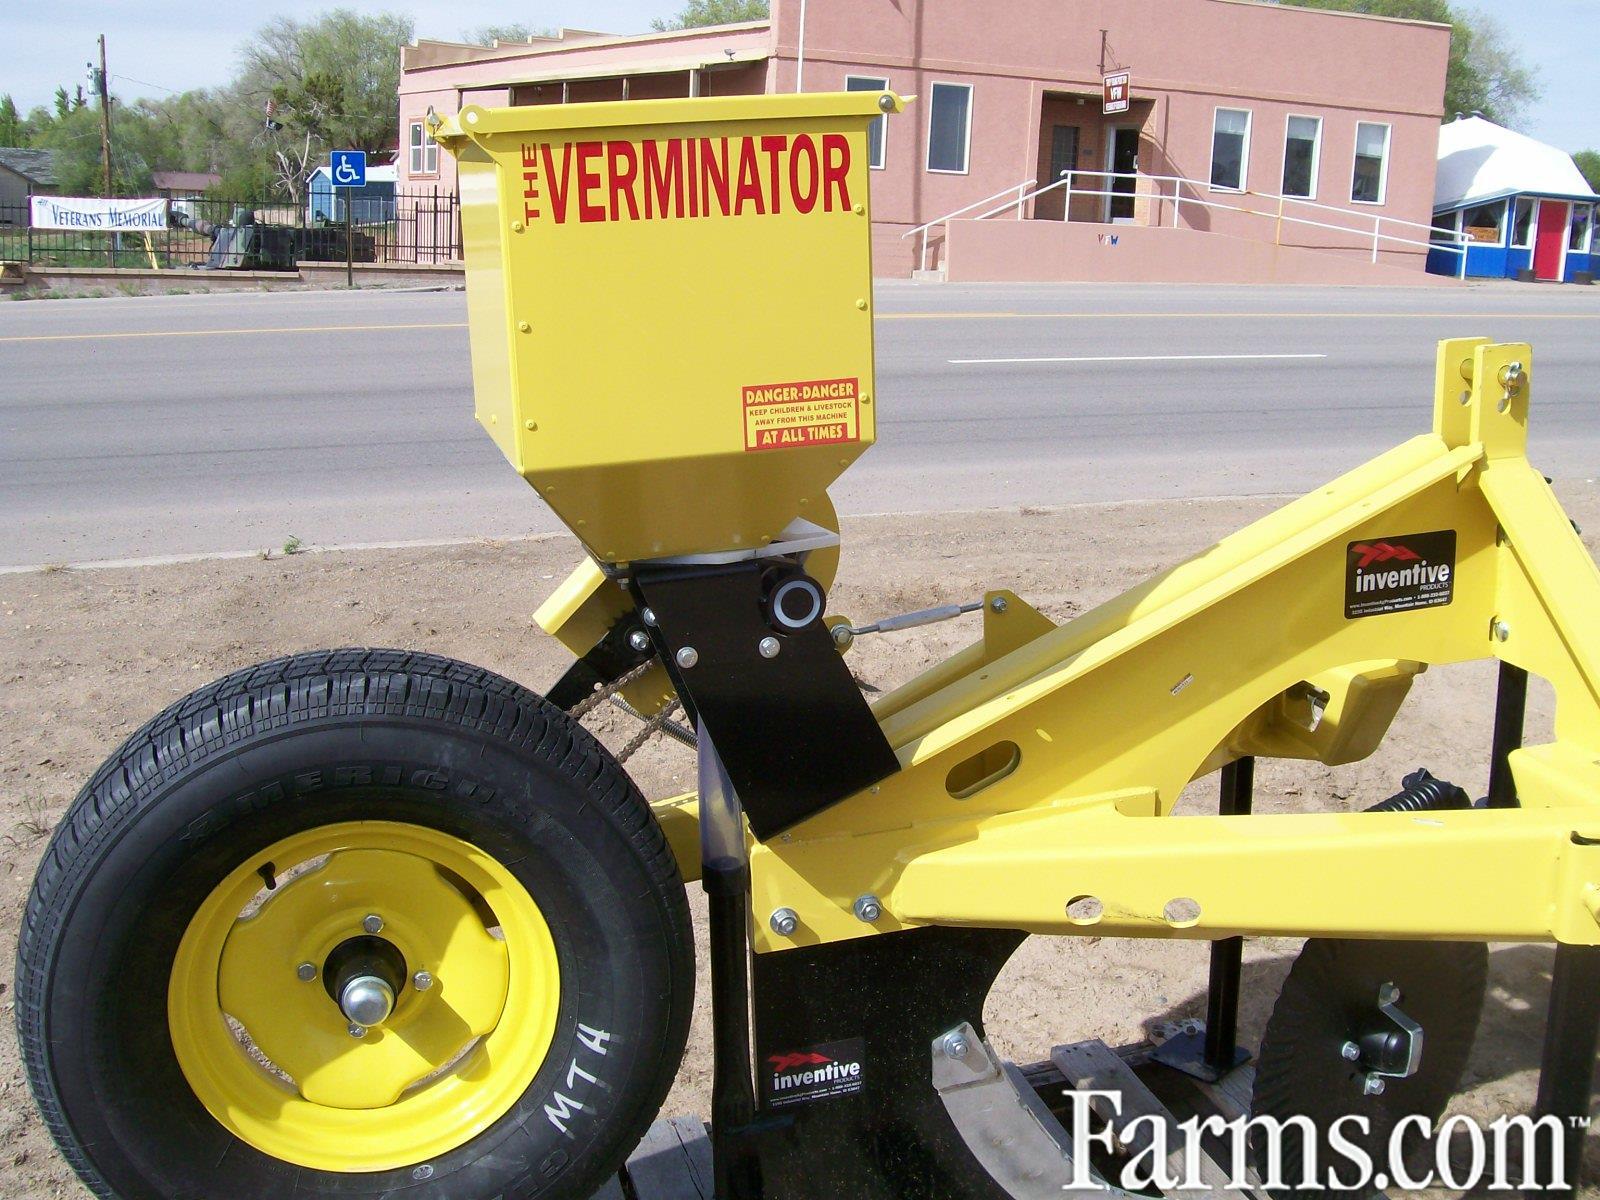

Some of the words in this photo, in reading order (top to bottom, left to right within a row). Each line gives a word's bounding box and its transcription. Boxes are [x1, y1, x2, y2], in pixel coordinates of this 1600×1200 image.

[521, 142, 541, 226] THE
[540, 133, 852, 225] VERMINATOR
[51, 204, 102, 227] VETERANS
[109, 206, 164, 227] MEMORIAL
[749, 408, 768, 417] KEEP
[769, 406, 806, 415] CHILDREN
[813, 401, 853, 411] LIVESTOCK
[754, 418, 775, 426] AWAY
[776, 416, 797, 425] FROM
[798, 414, 815, 423] THIS
[815, 411, 848, 421] MACHINE
[762, 429, 778, 445] AT
[780, 428, 806, 444] ALL
[807, 424, 844, 441] TIMES
[1355, 560, 1451, 593] inventive
[1419, 581, 1449, 591] PRODUCTS
[773, 1061, 860, 1091] inventive
